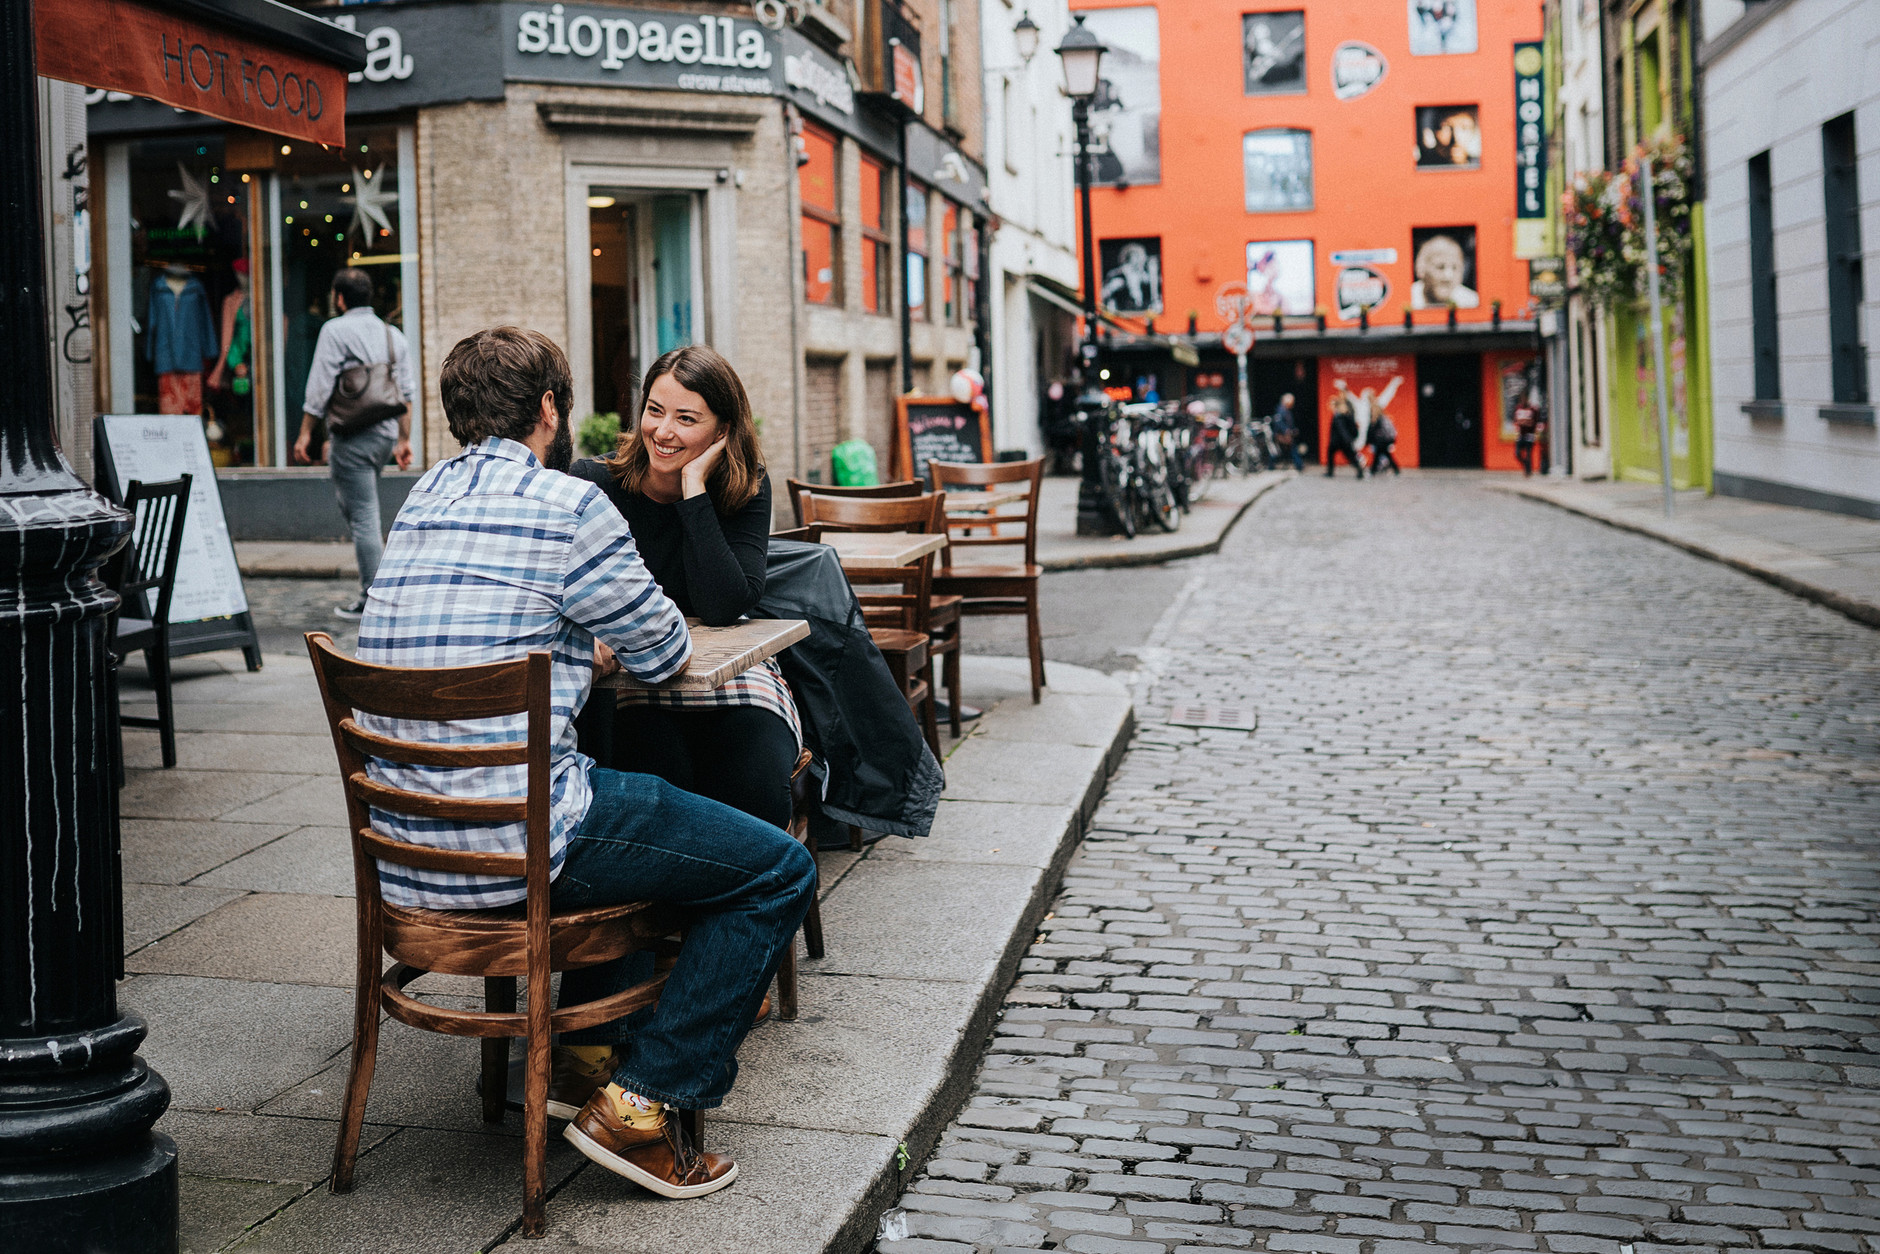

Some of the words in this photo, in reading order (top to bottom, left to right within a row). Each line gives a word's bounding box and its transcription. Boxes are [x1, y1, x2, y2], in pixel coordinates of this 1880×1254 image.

[518, 3, 772, 69] siopaella
[162, 33, 229, 97] HOT
[241, 58, 323, 122] FOOD
